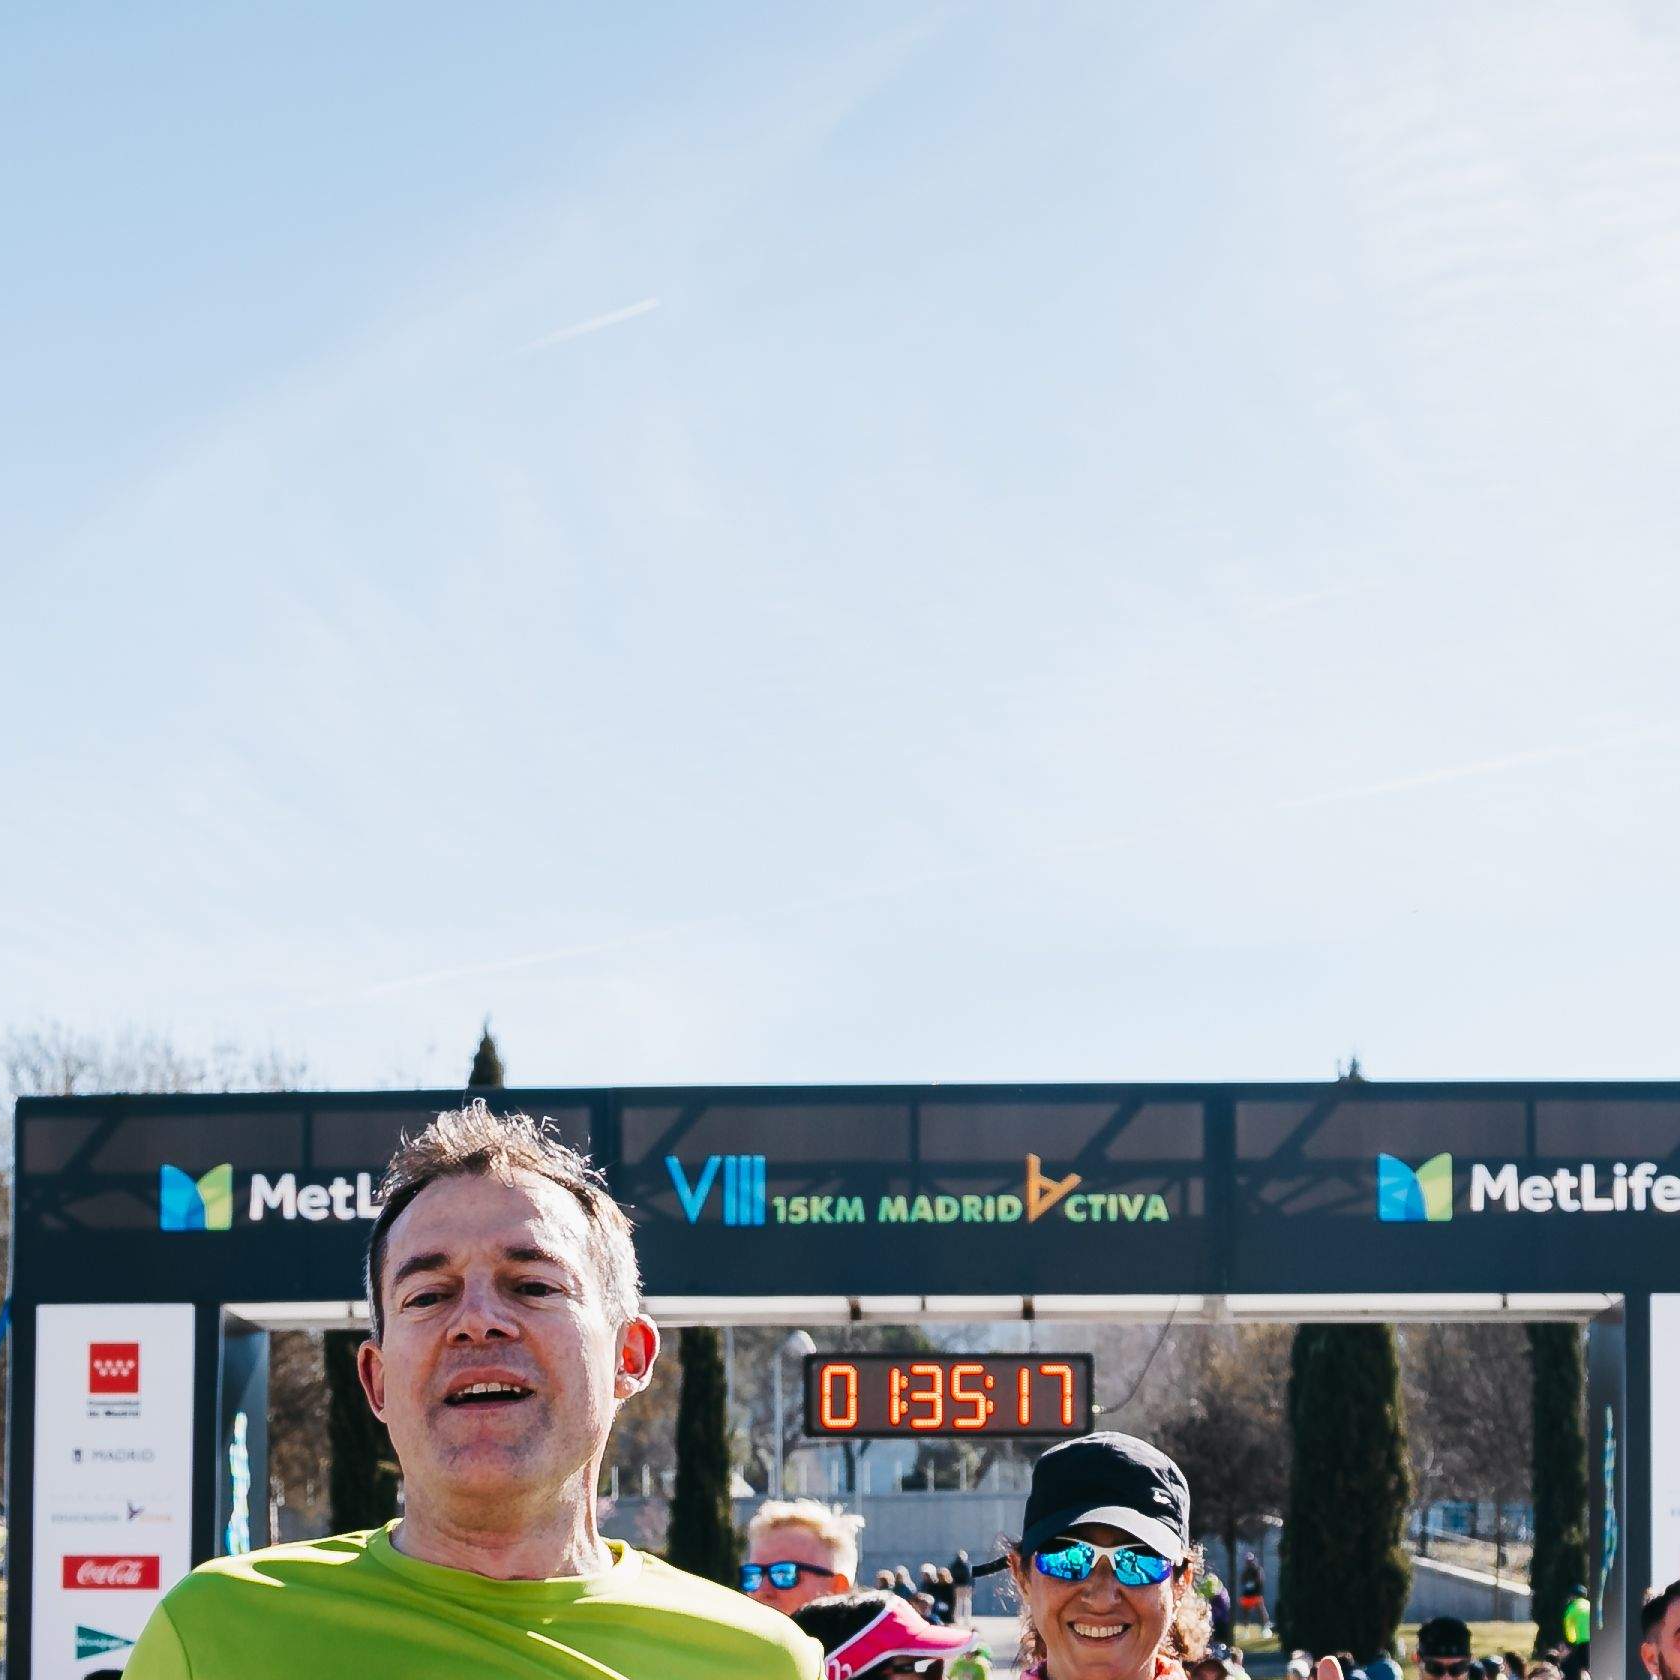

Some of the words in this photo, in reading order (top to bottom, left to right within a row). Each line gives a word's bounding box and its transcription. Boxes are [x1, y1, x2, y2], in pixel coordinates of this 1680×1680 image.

[249, 1170, 384, 1222] MetL
[665, 1154, 767, 1226] VIII
[772, 1194, 866, 1225] 15KM
[877, 1193, 1024, 1224] MADRID
